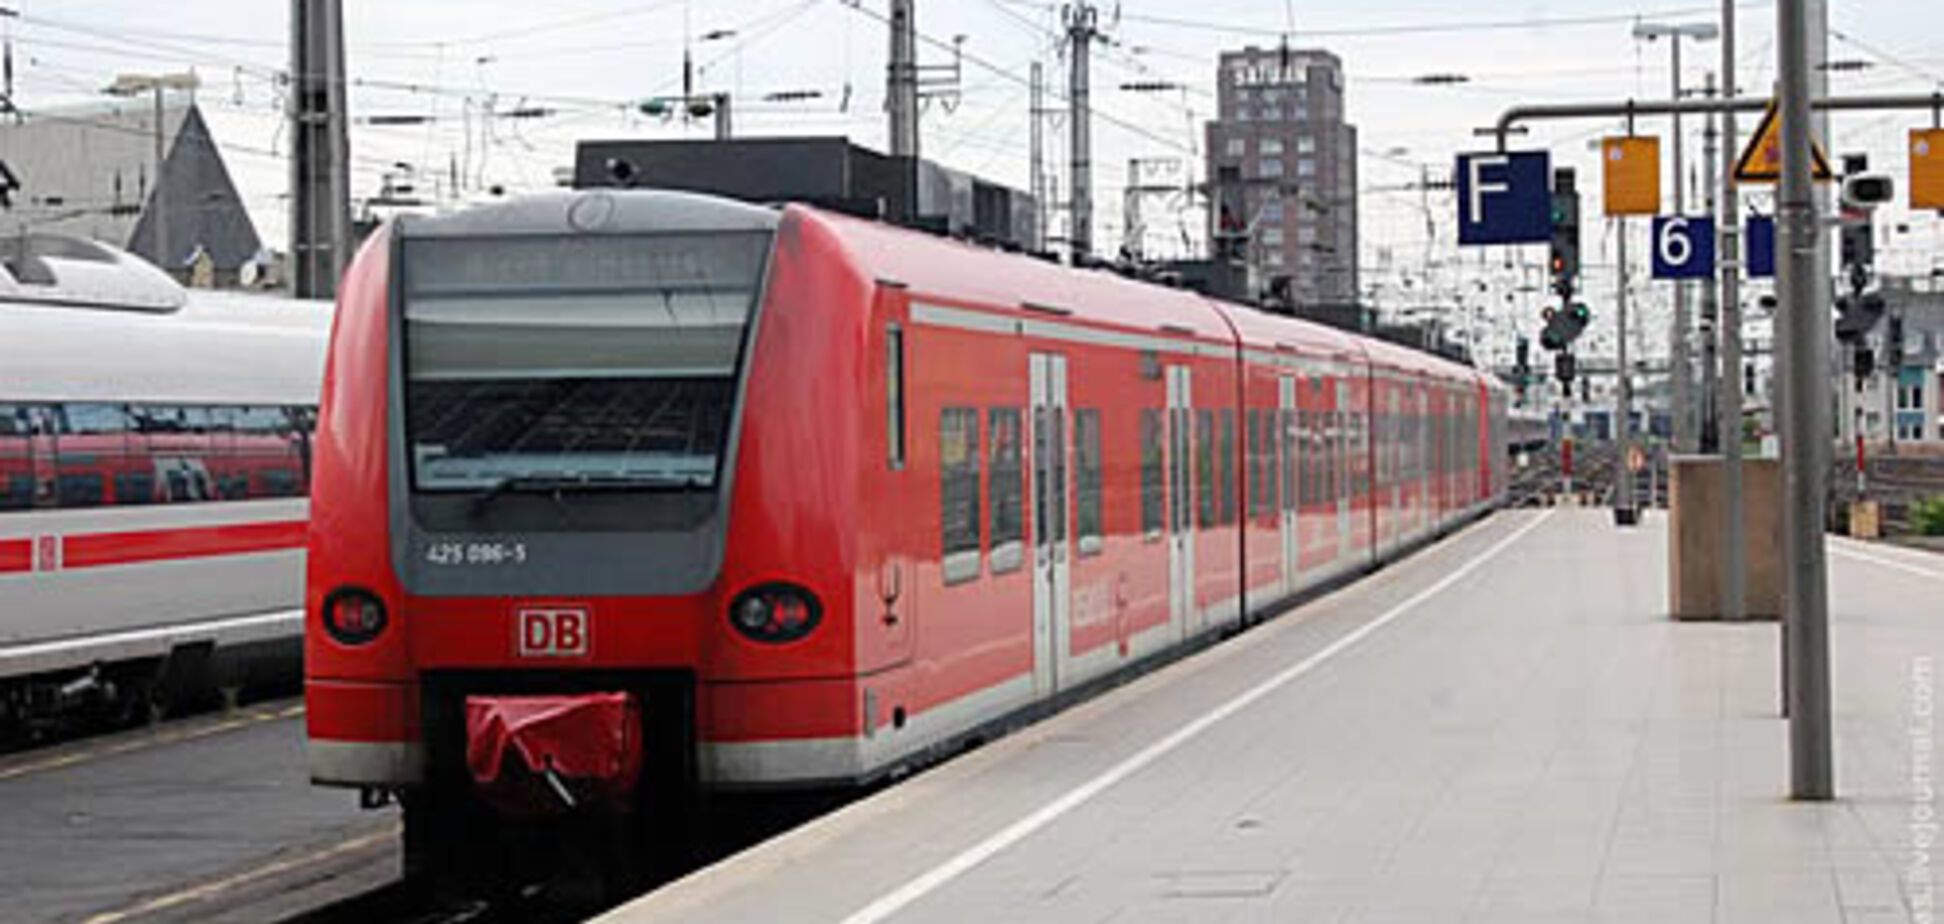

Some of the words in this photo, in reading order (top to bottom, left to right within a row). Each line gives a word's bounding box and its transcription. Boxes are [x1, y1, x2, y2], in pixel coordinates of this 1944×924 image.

[1469, 154, 1509, 223] F
[1660, 218, 1691, 265] 6
[427, 543, 463, 564] 425
[523, 612, 582, 652] DB
